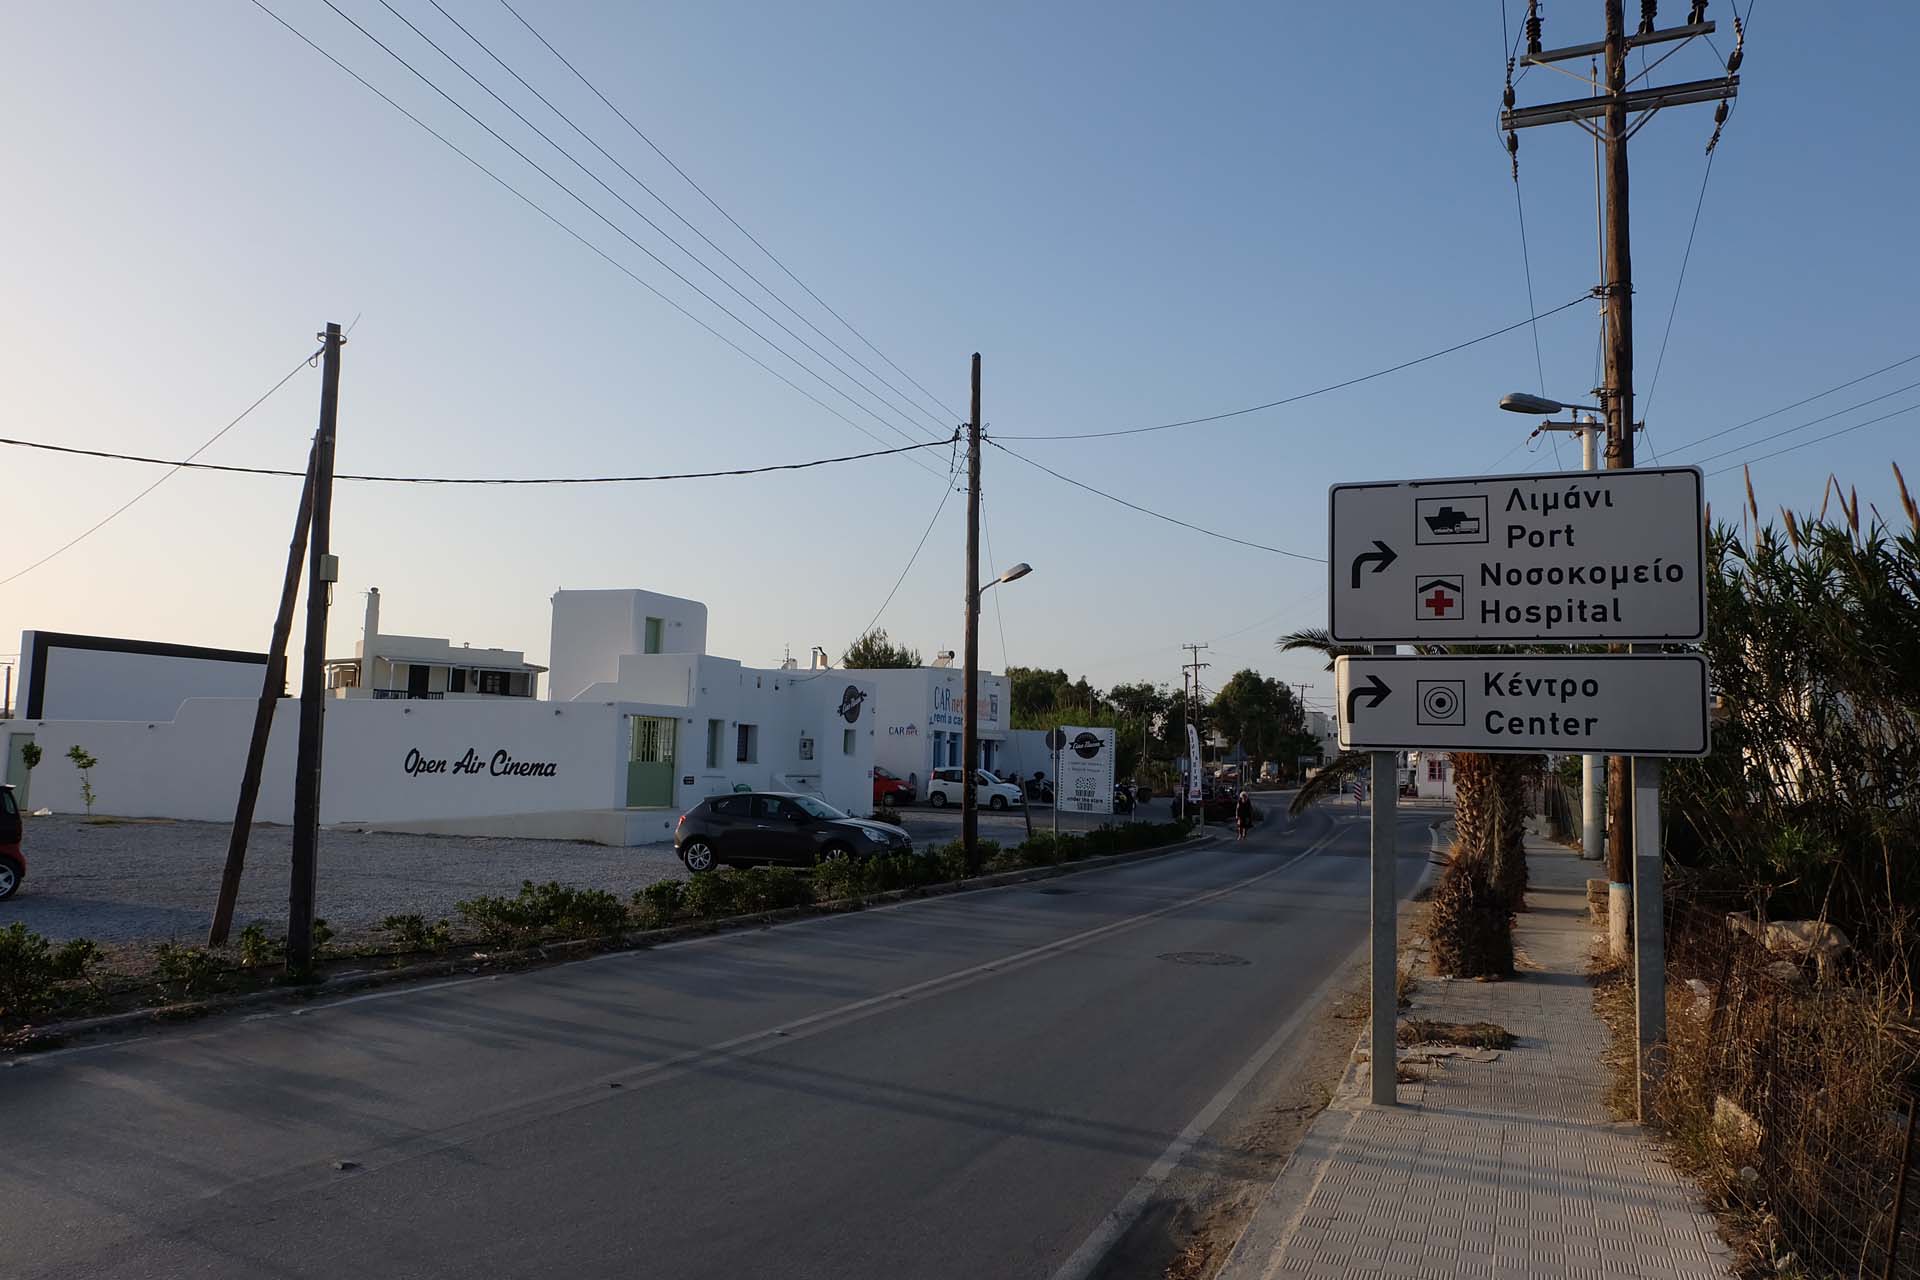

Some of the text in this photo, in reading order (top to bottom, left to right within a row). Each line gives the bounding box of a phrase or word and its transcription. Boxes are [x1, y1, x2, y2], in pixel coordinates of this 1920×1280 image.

[1505, 484, 1613, 516] Λιμάνι
[1507, 523, 1575, 549] Port
[1480, 558, 1684, 590] Νοσοκομείο
[1480, 598, 1622, 629] Hospital
[1484, 671, 1599, 703] Κέντρο
[934, 713, 947, 725] rent
[1484, 710, 1598, 736] Center
[404, 747, 557, 777] Open Air Cinema
